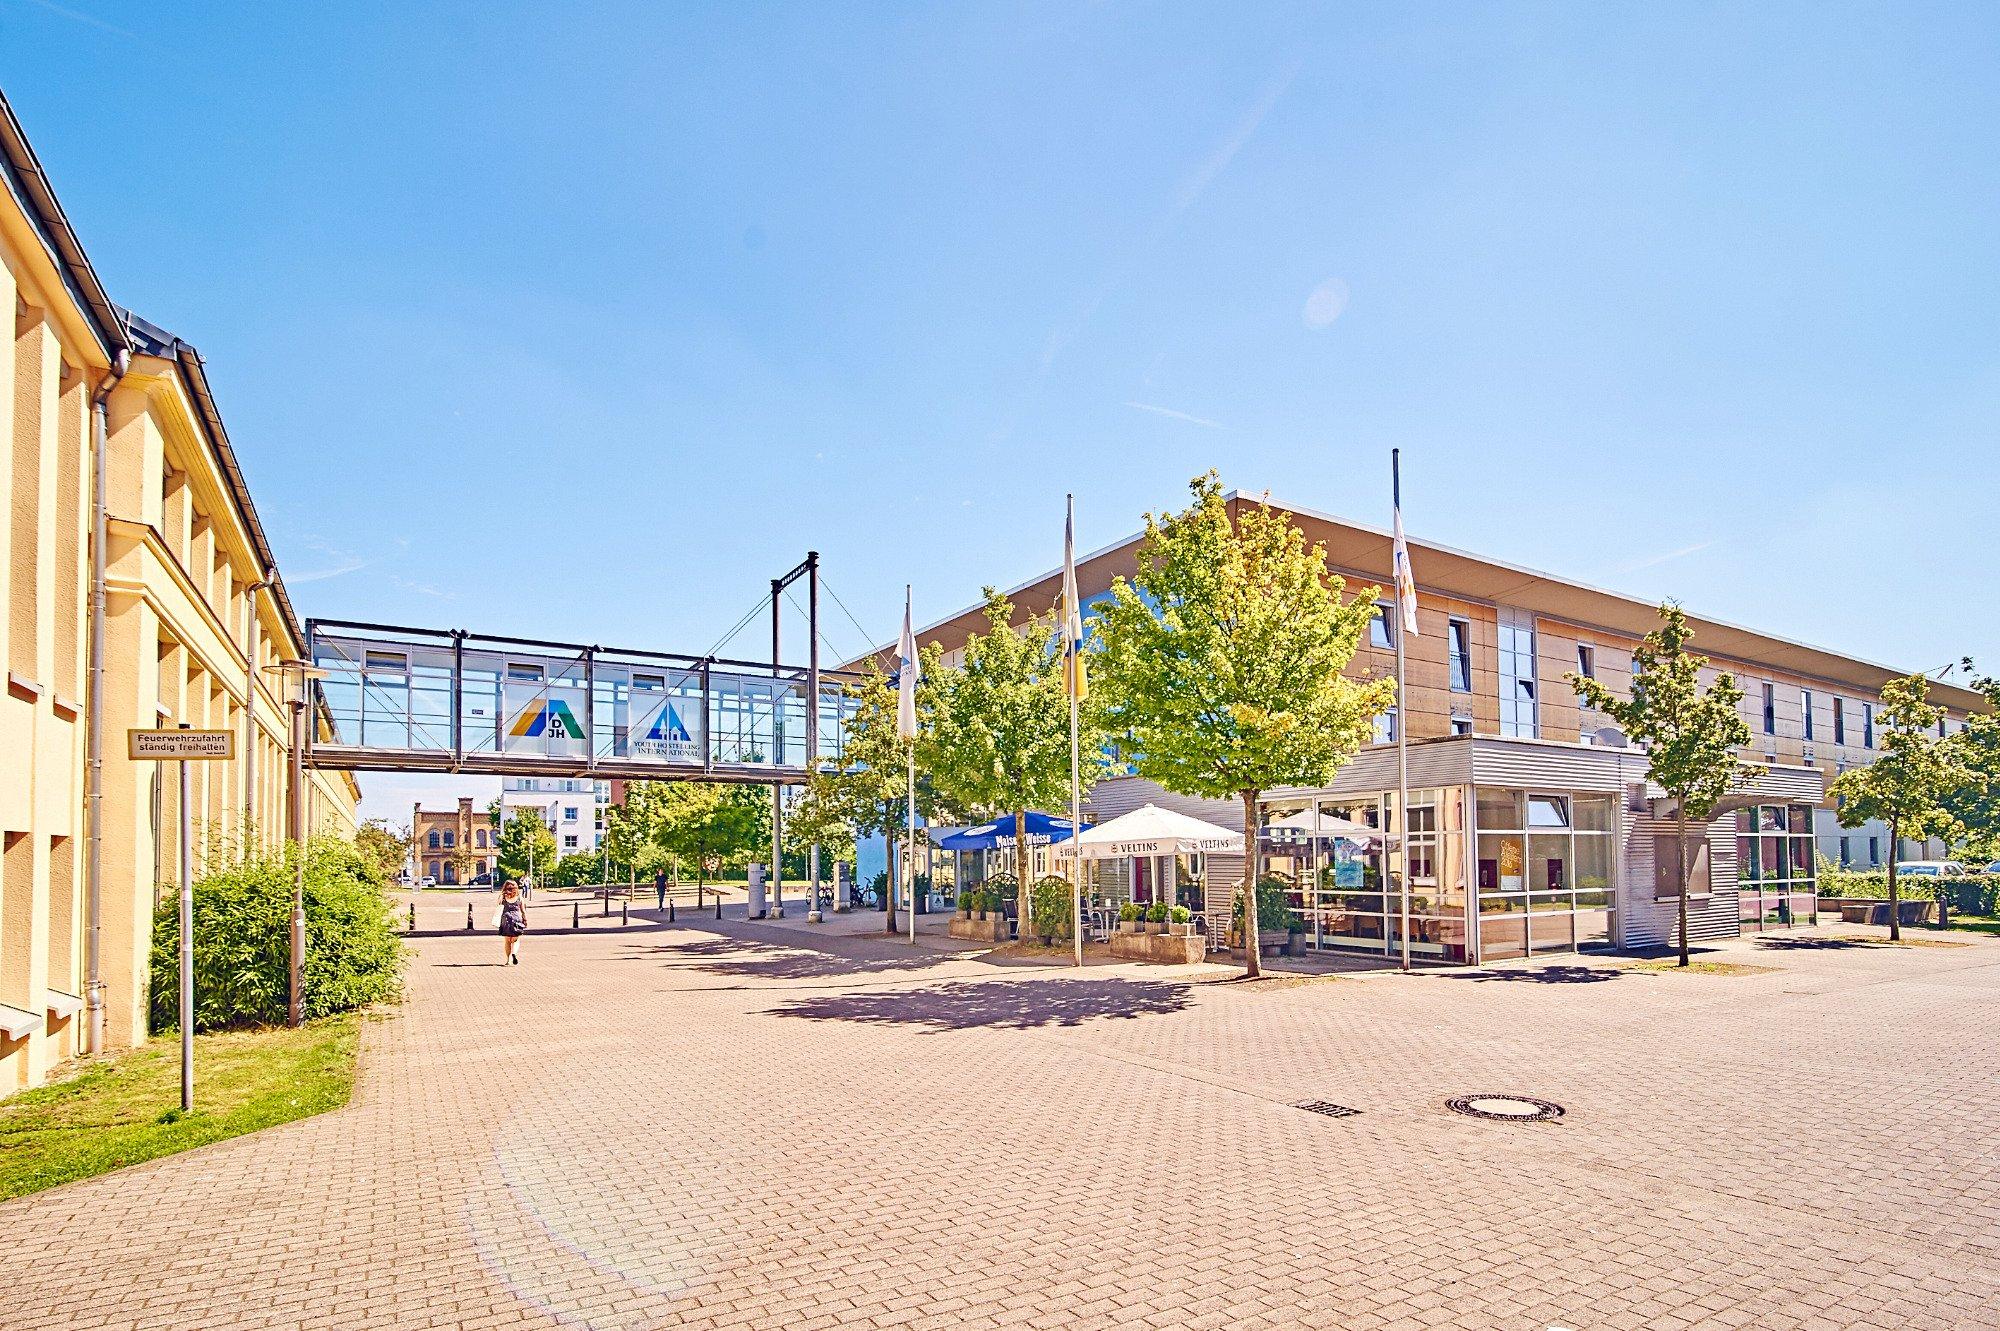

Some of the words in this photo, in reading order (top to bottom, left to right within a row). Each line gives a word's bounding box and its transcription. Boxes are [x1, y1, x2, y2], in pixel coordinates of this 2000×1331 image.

[551, 719, 562, 728] D
[137, 734, 225, 742] Feuerwehrzufahrt
[548, 729, 565, 738] JH
[139, 743, 175, 752] ständig
[179, 743, 225, 751] freihalten
[657, 742, 701, 750] HOSTELLING
[638, 747, 700, 757] INTERNATIONAL
[1025, 833, 1051, 845] Weisse
[1120, 842, 1158, 853] VELTINS
[1200, 839, 1229, 849] VELTINS
[1064, 846, 1084, 857] VELTS
